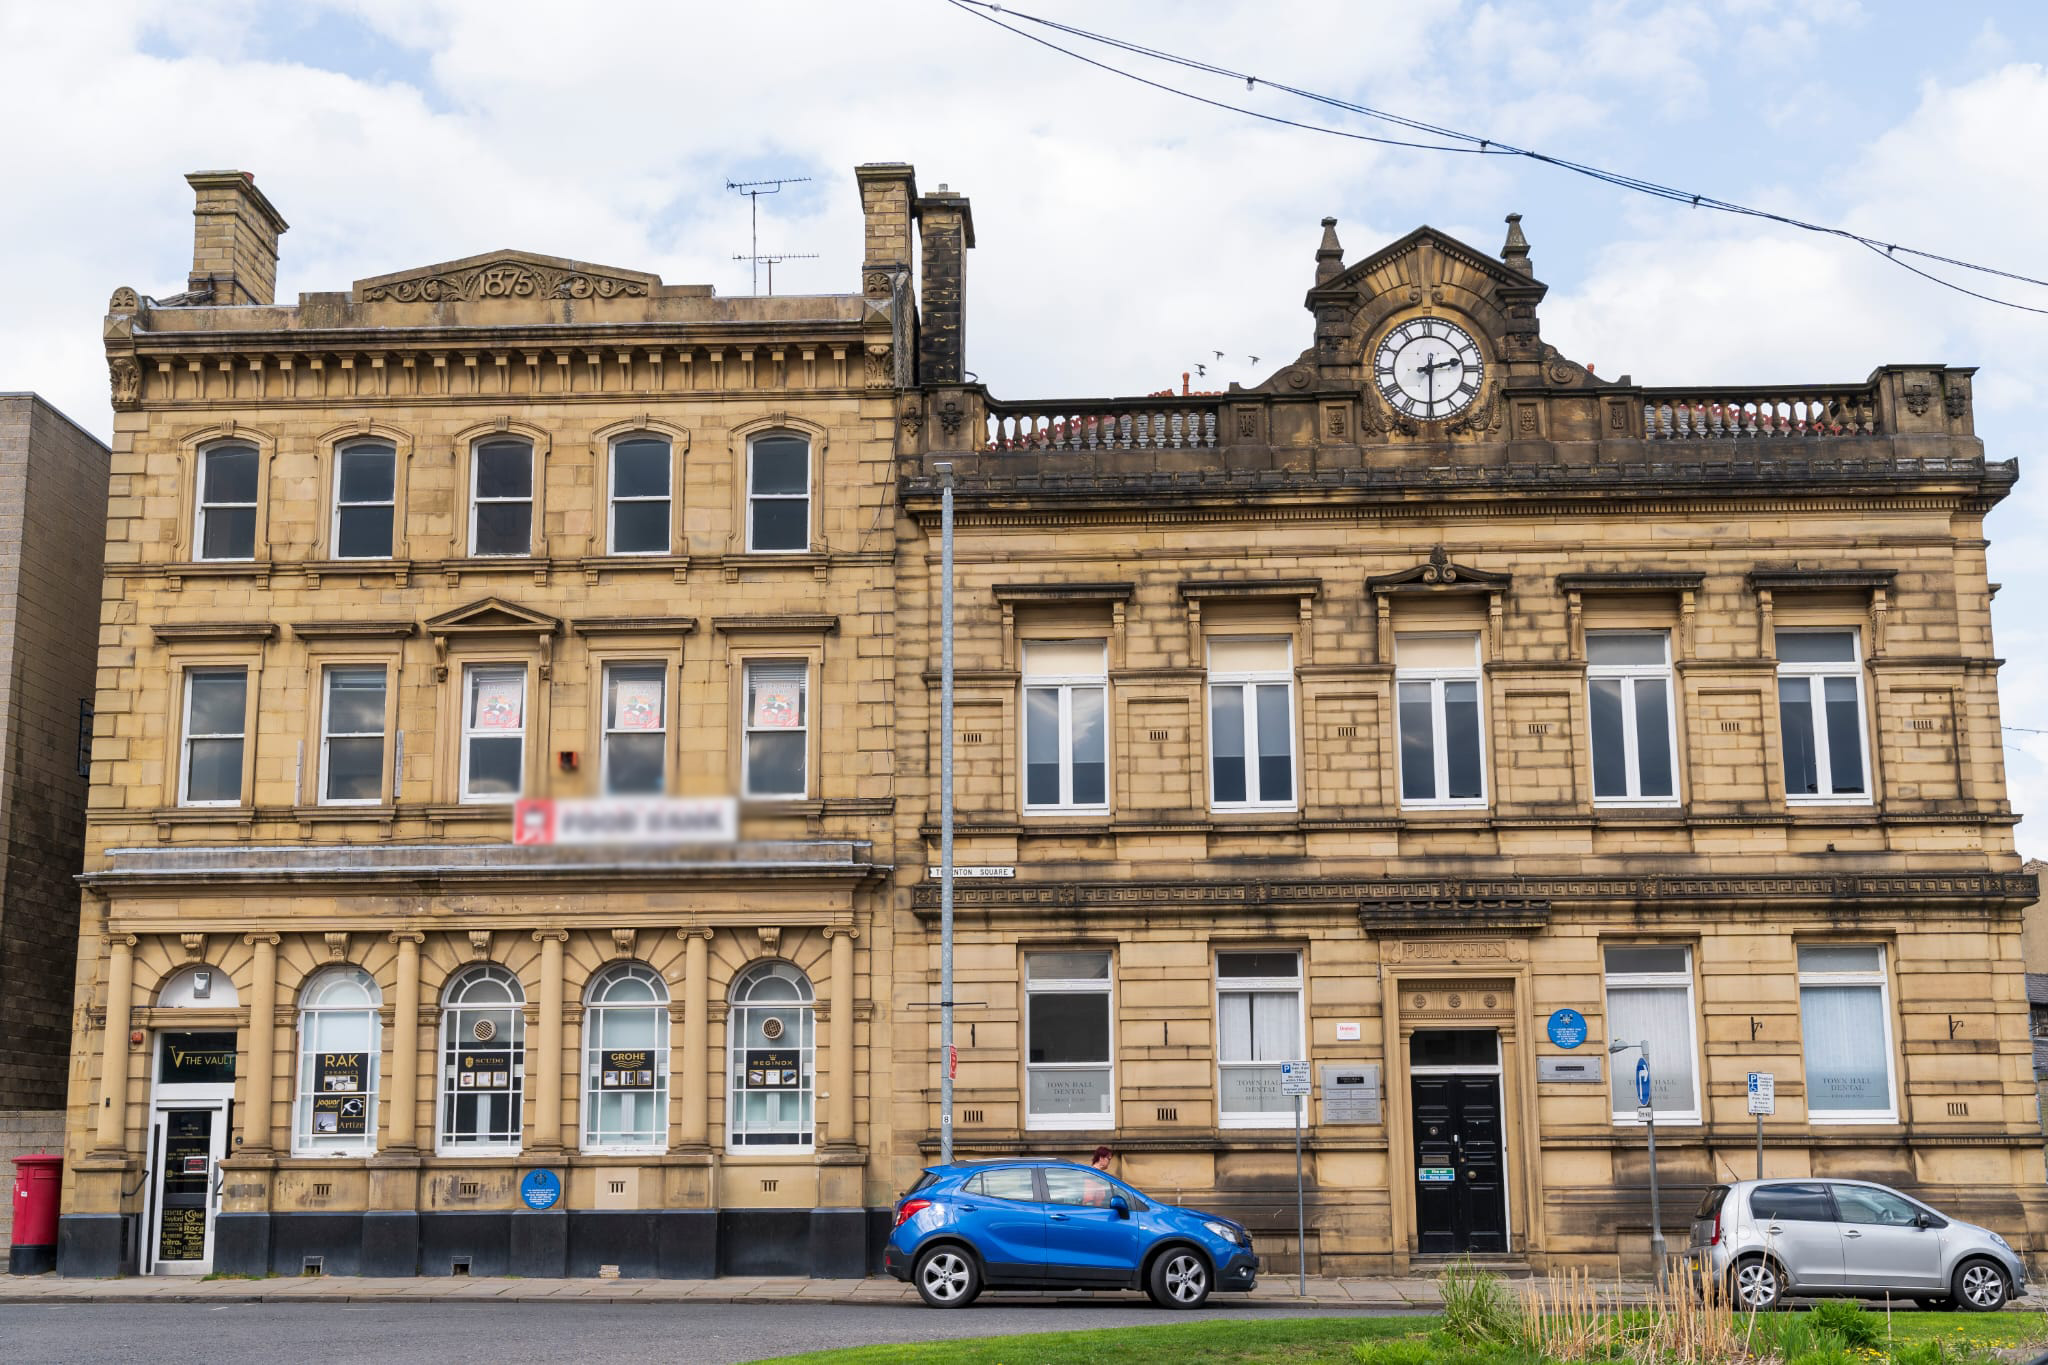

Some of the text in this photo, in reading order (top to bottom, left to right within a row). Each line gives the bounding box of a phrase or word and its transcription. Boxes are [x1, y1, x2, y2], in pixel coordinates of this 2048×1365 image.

[479, 269, 534, 297] 1875
[935, 868, 1009, 876] TNTON SQUARE
[1405, 943, 1504, 958] PUBLIC OFFICES
[185, 1056, 233, 1065] THE VAULT
[325, 1055, 359, 1068] RAK
[611, 1053, 646, 1061] GROHE
[339, 1121, 366, 1129] Artize
